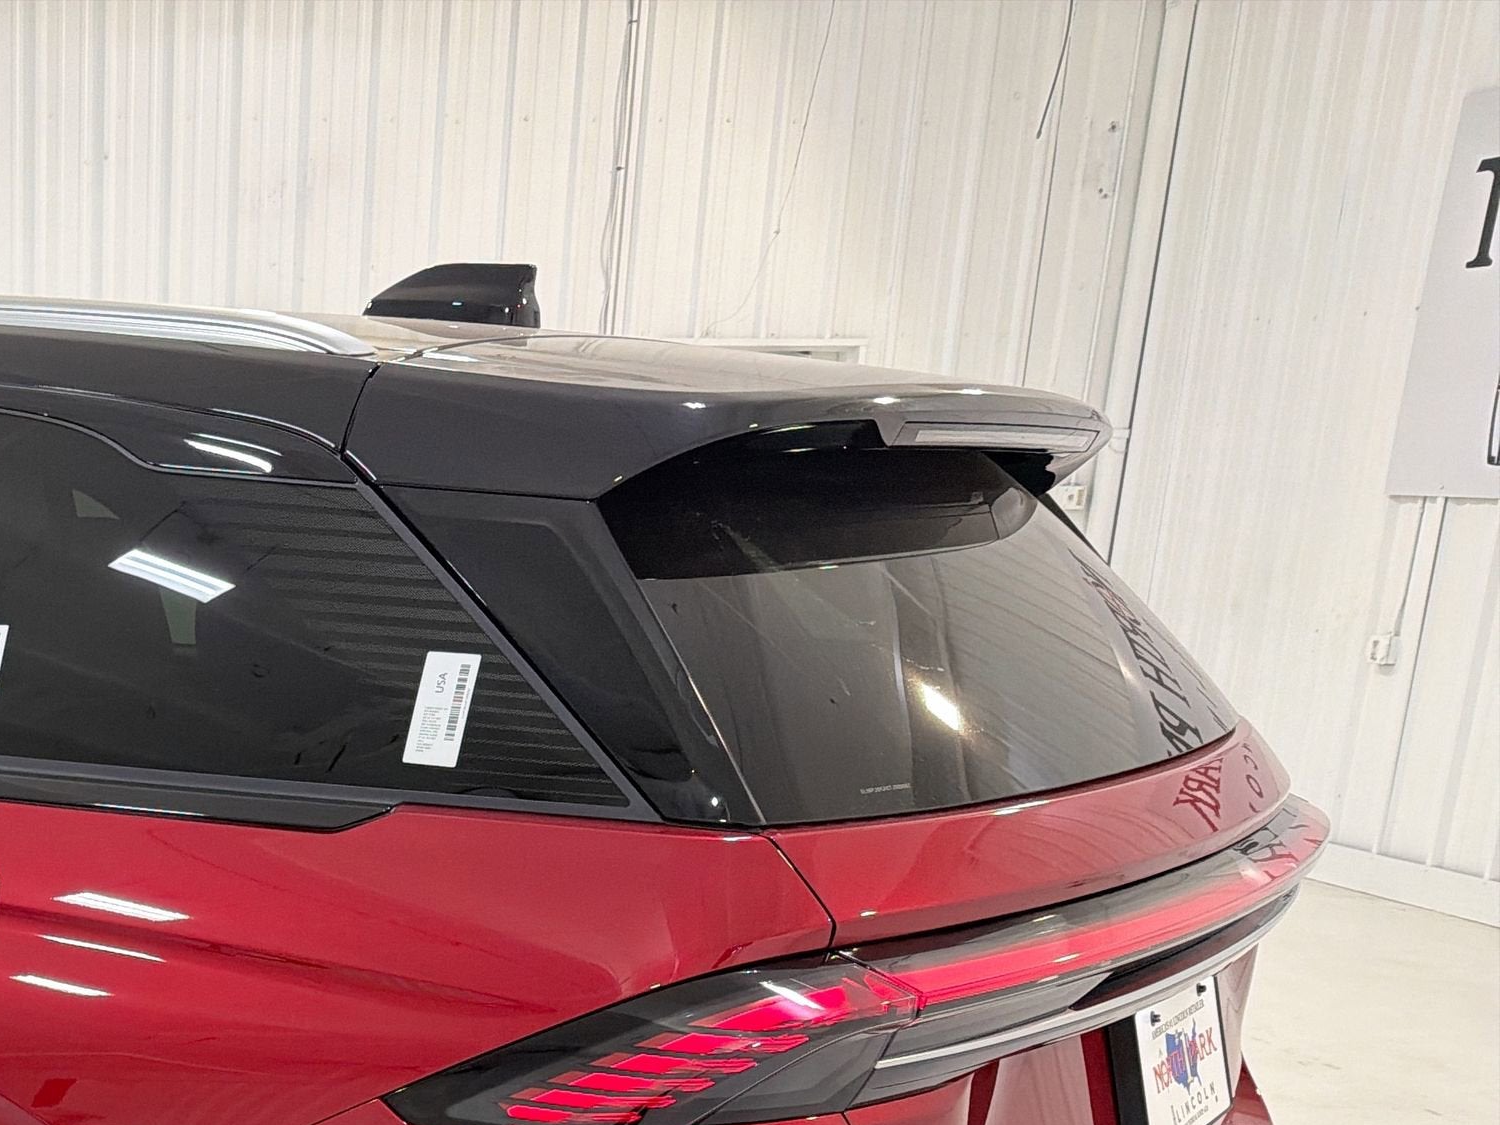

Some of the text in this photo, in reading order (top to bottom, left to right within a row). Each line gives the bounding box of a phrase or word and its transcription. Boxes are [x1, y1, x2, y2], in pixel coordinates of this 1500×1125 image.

[435, 672, 448, 694] USA
[1152, 1050, 1185, 1095] NORTH
[1175, 1081, 1216, 1123] LINCOLN
